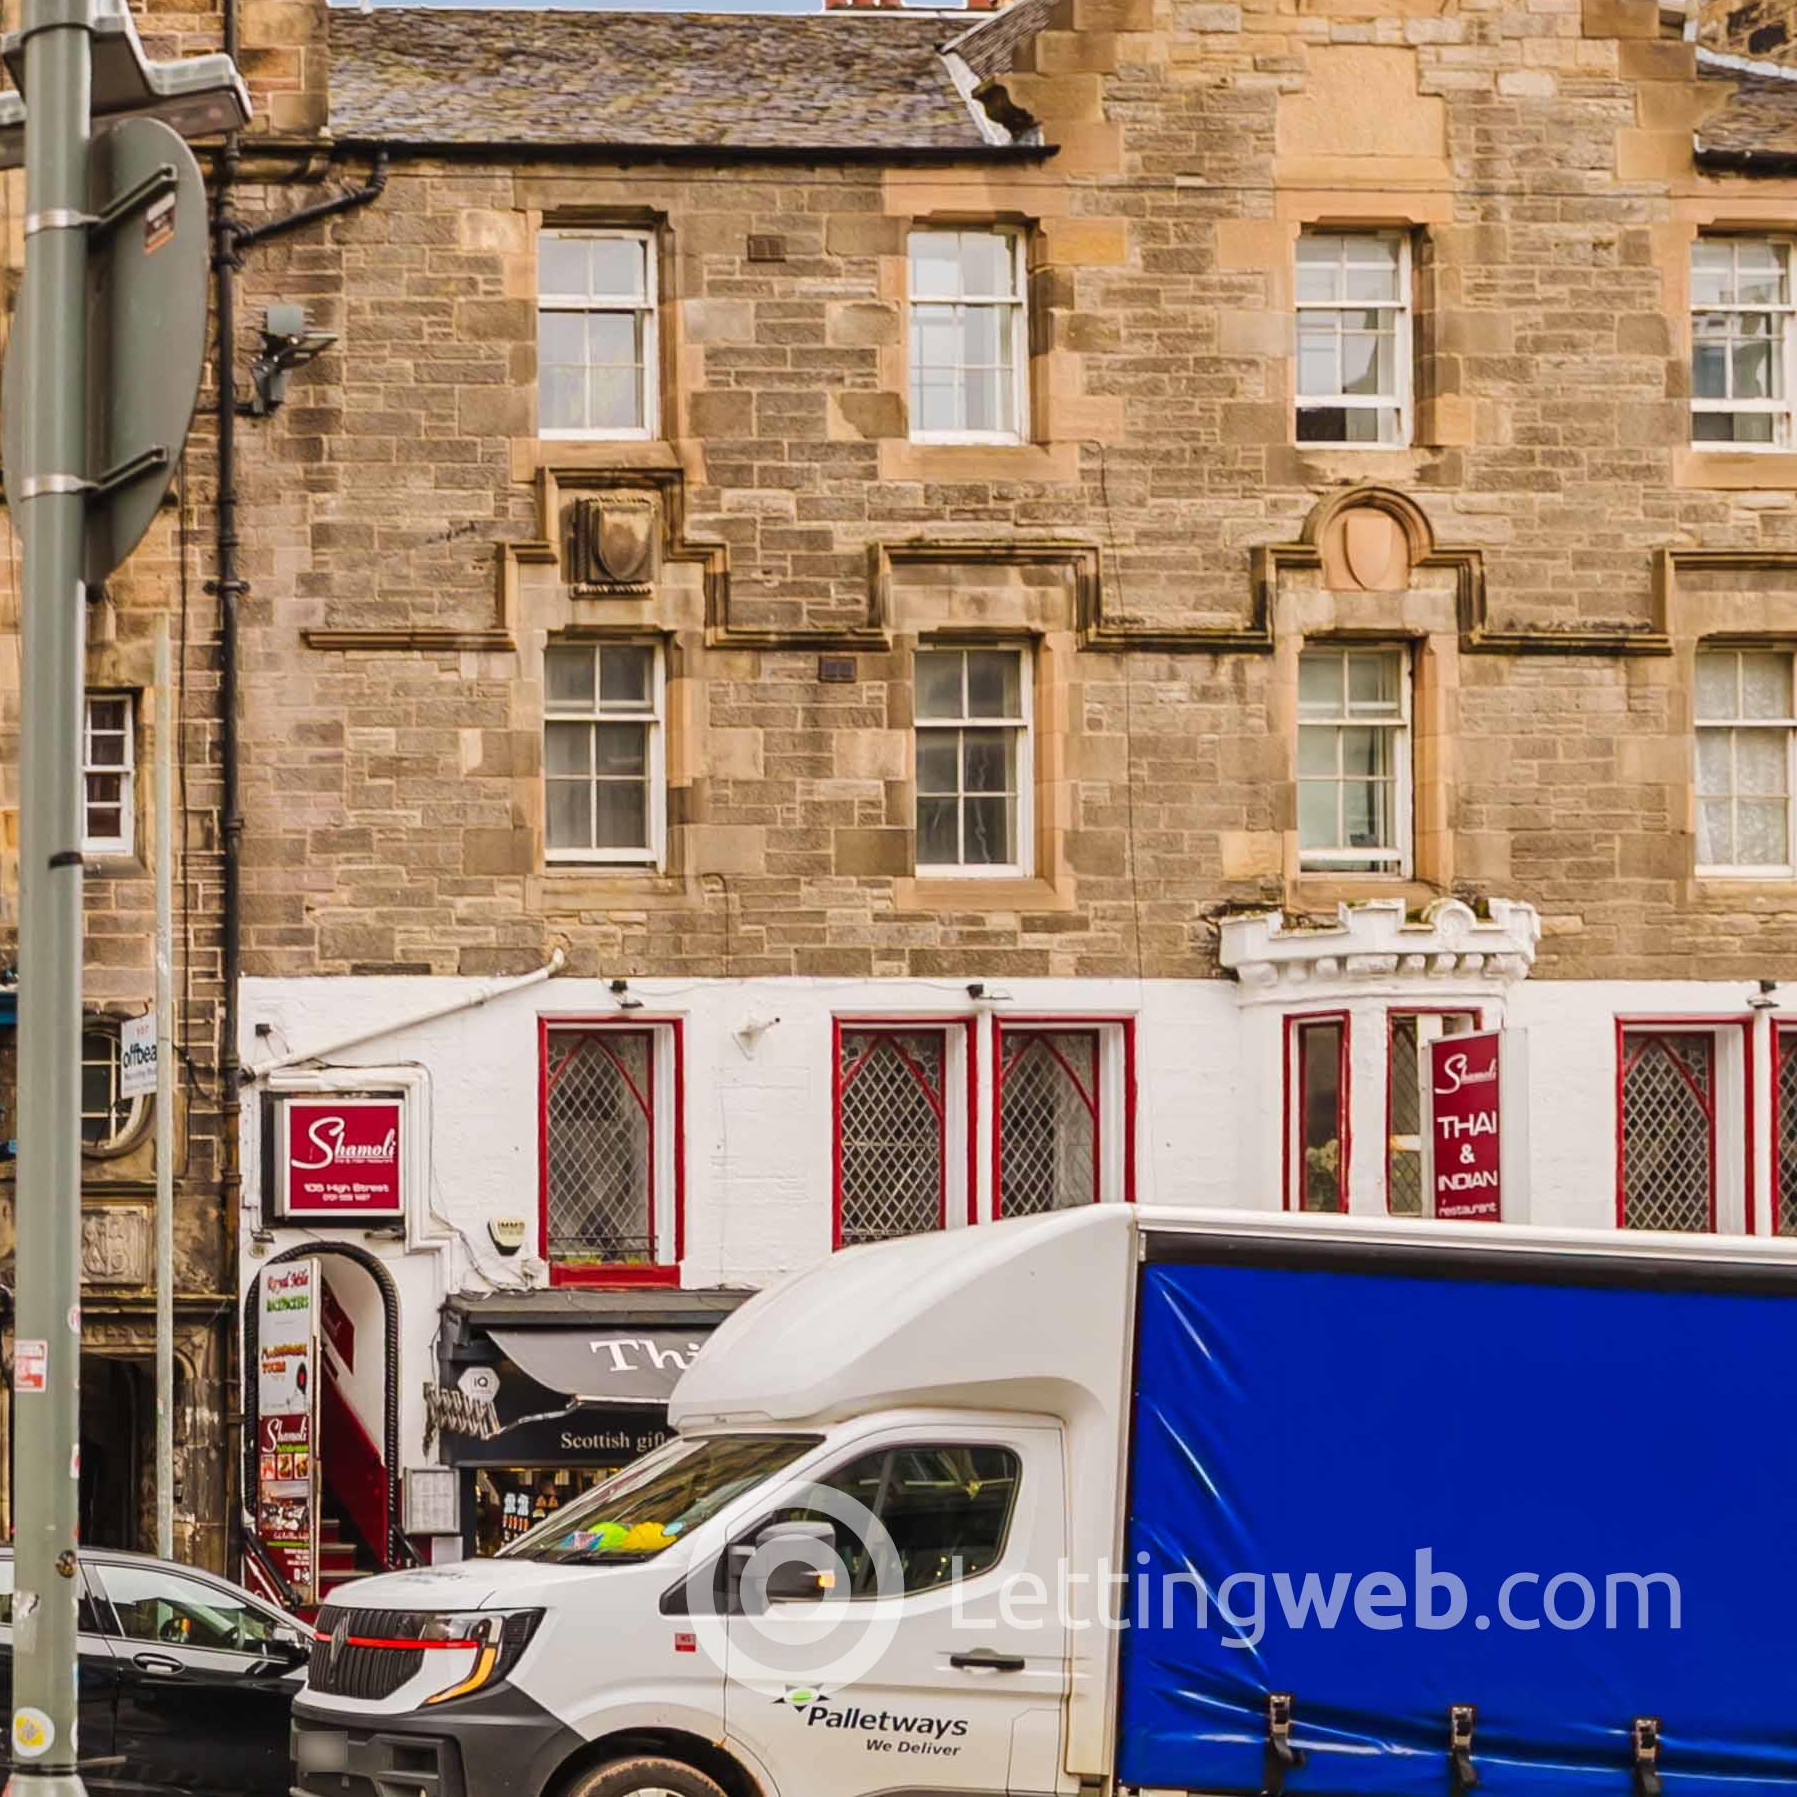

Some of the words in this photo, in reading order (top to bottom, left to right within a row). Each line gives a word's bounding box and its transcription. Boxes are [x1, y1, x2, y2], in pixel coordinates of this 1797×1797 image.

[123, 1042, 157, 1068] offbea
[1437, 1111, 1497, 1139] THAI
[291, 1116, 396, 1170] Shamoli
[1459, 1143, 1475, 1164] &
[326, 1184, 351, 1193] High
[353, 1183, 389, 1192] Street
[1438, 1170, 1498, 1192] INDIAN
[1438, 1202, 1497, 1217] restaurant
[561, 1432, 630, 1448] Scottish
[807, 1706, 969, 1739] Palletways
[866, 1739, 892, 1752] We
[897, 1741, 961, 1756] Deliver
